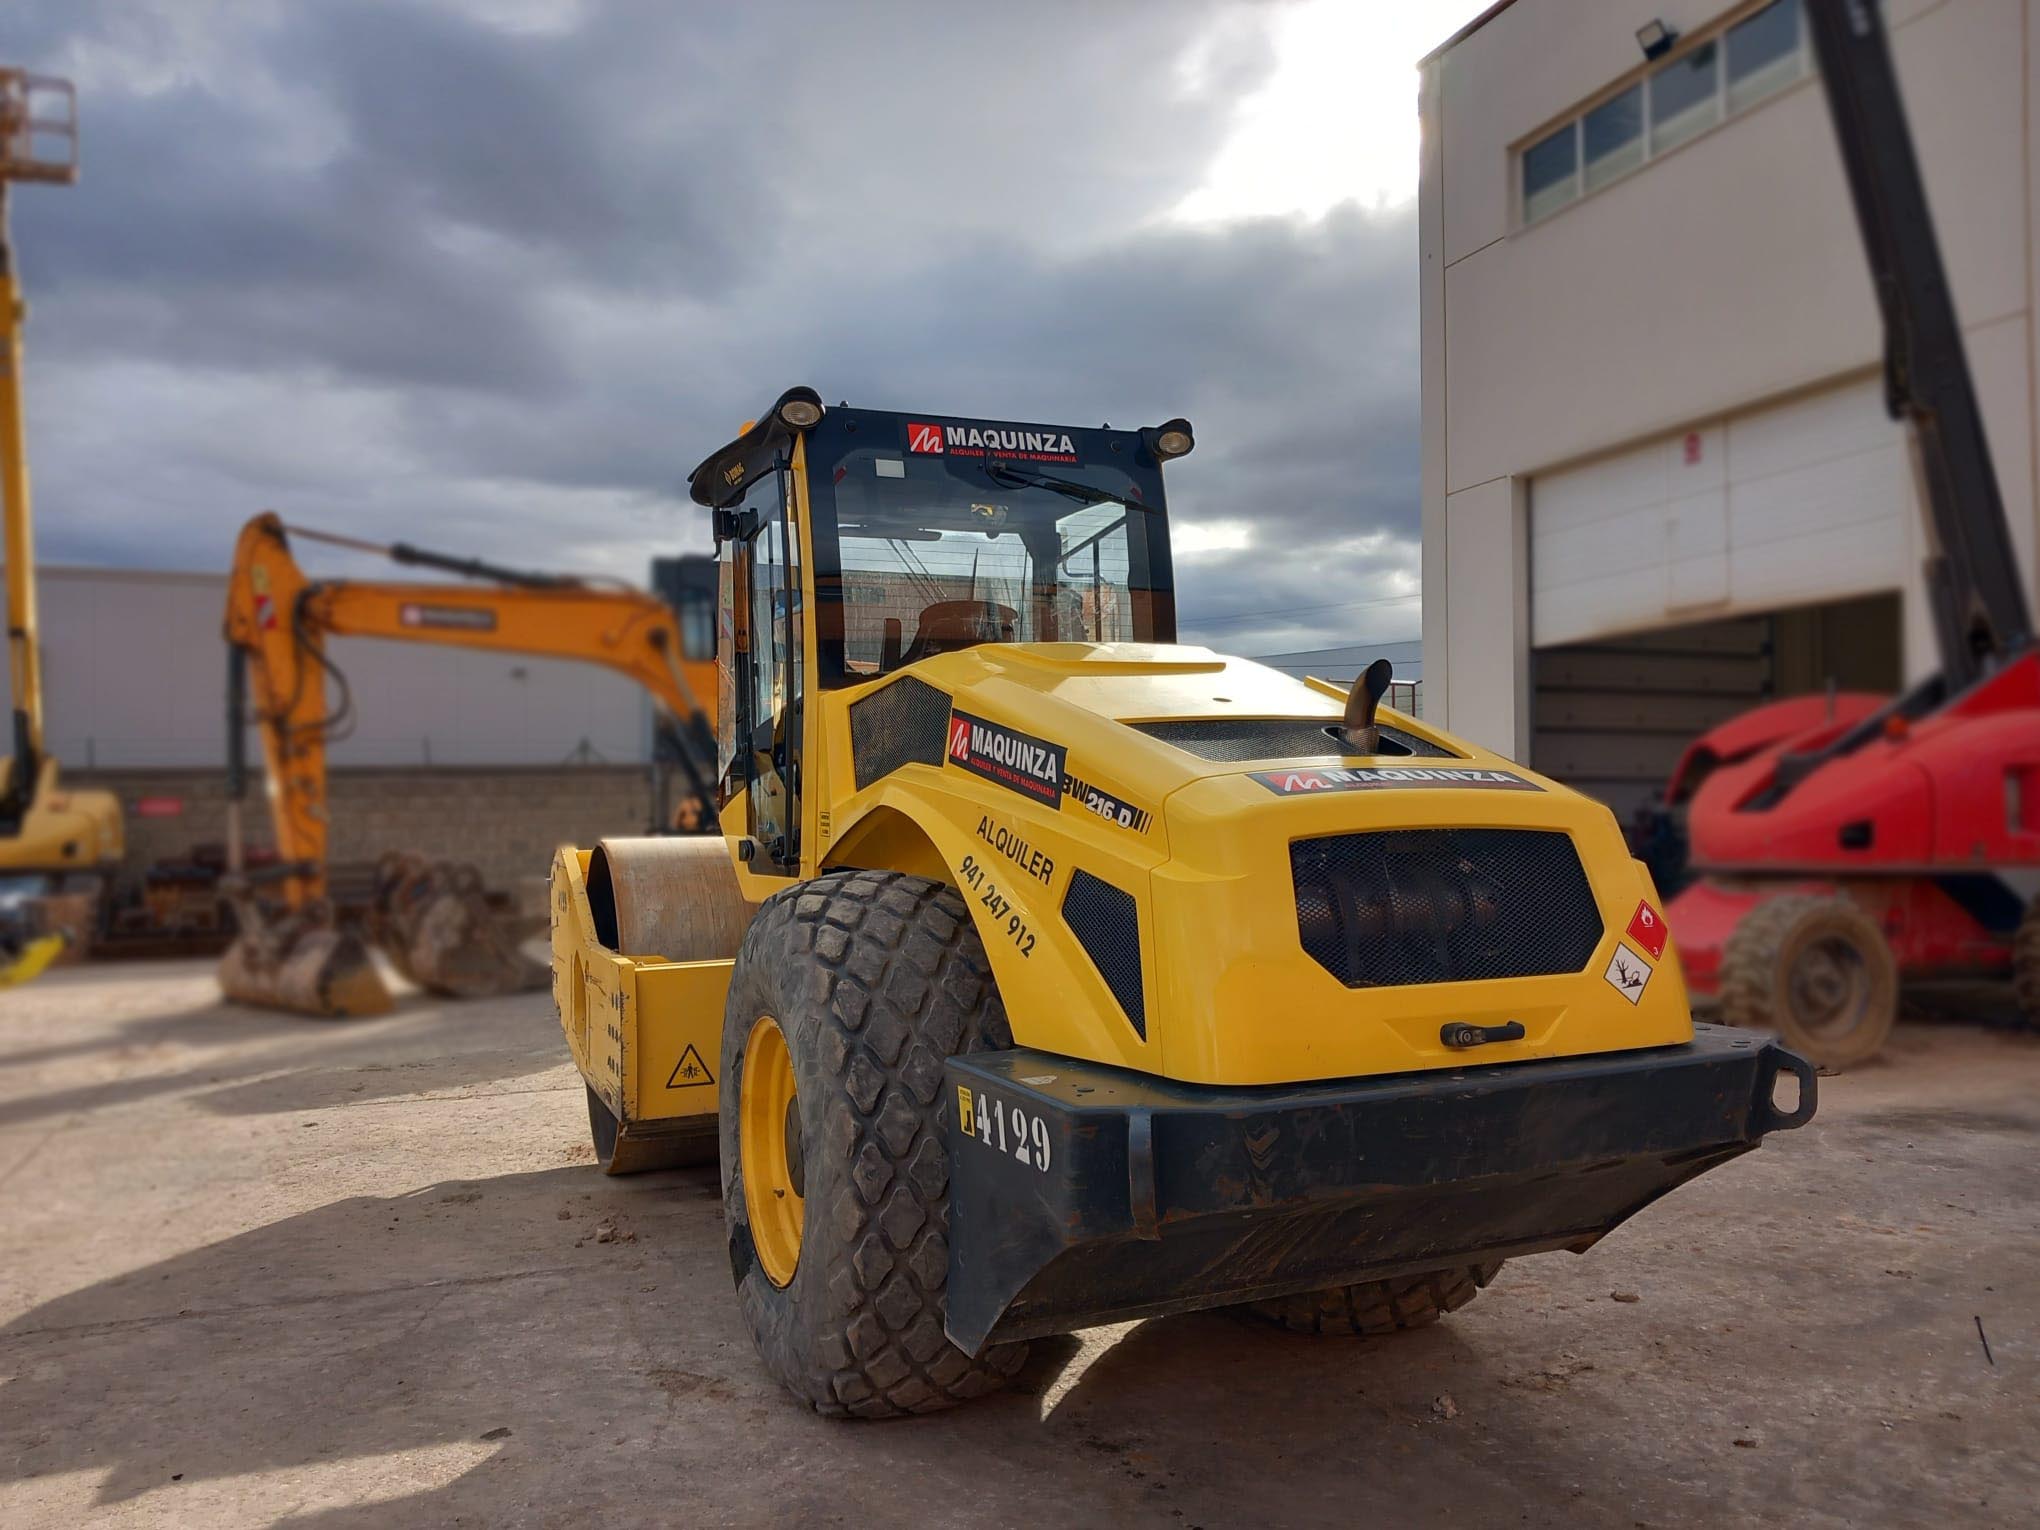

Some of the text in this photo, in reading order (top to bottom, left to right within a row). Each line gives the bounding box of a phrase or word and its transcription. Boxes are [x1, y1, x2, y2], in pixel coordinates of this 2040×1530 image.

[946, 426, 1075, 454] MAQUINZA
[971, 724, 1057, 783] MAQUINZA
[1321, 770, 1520, 783] MAQUINZA
[1062, 774, 1132, 829] BW 216 D
[976, 815, 1055, 886] ALQUILER
[959, 855, 1036, 959] 941 247 912
[1653, 946, 1659, 955] 3
[976, 1093, 1051, 1172] 4129
